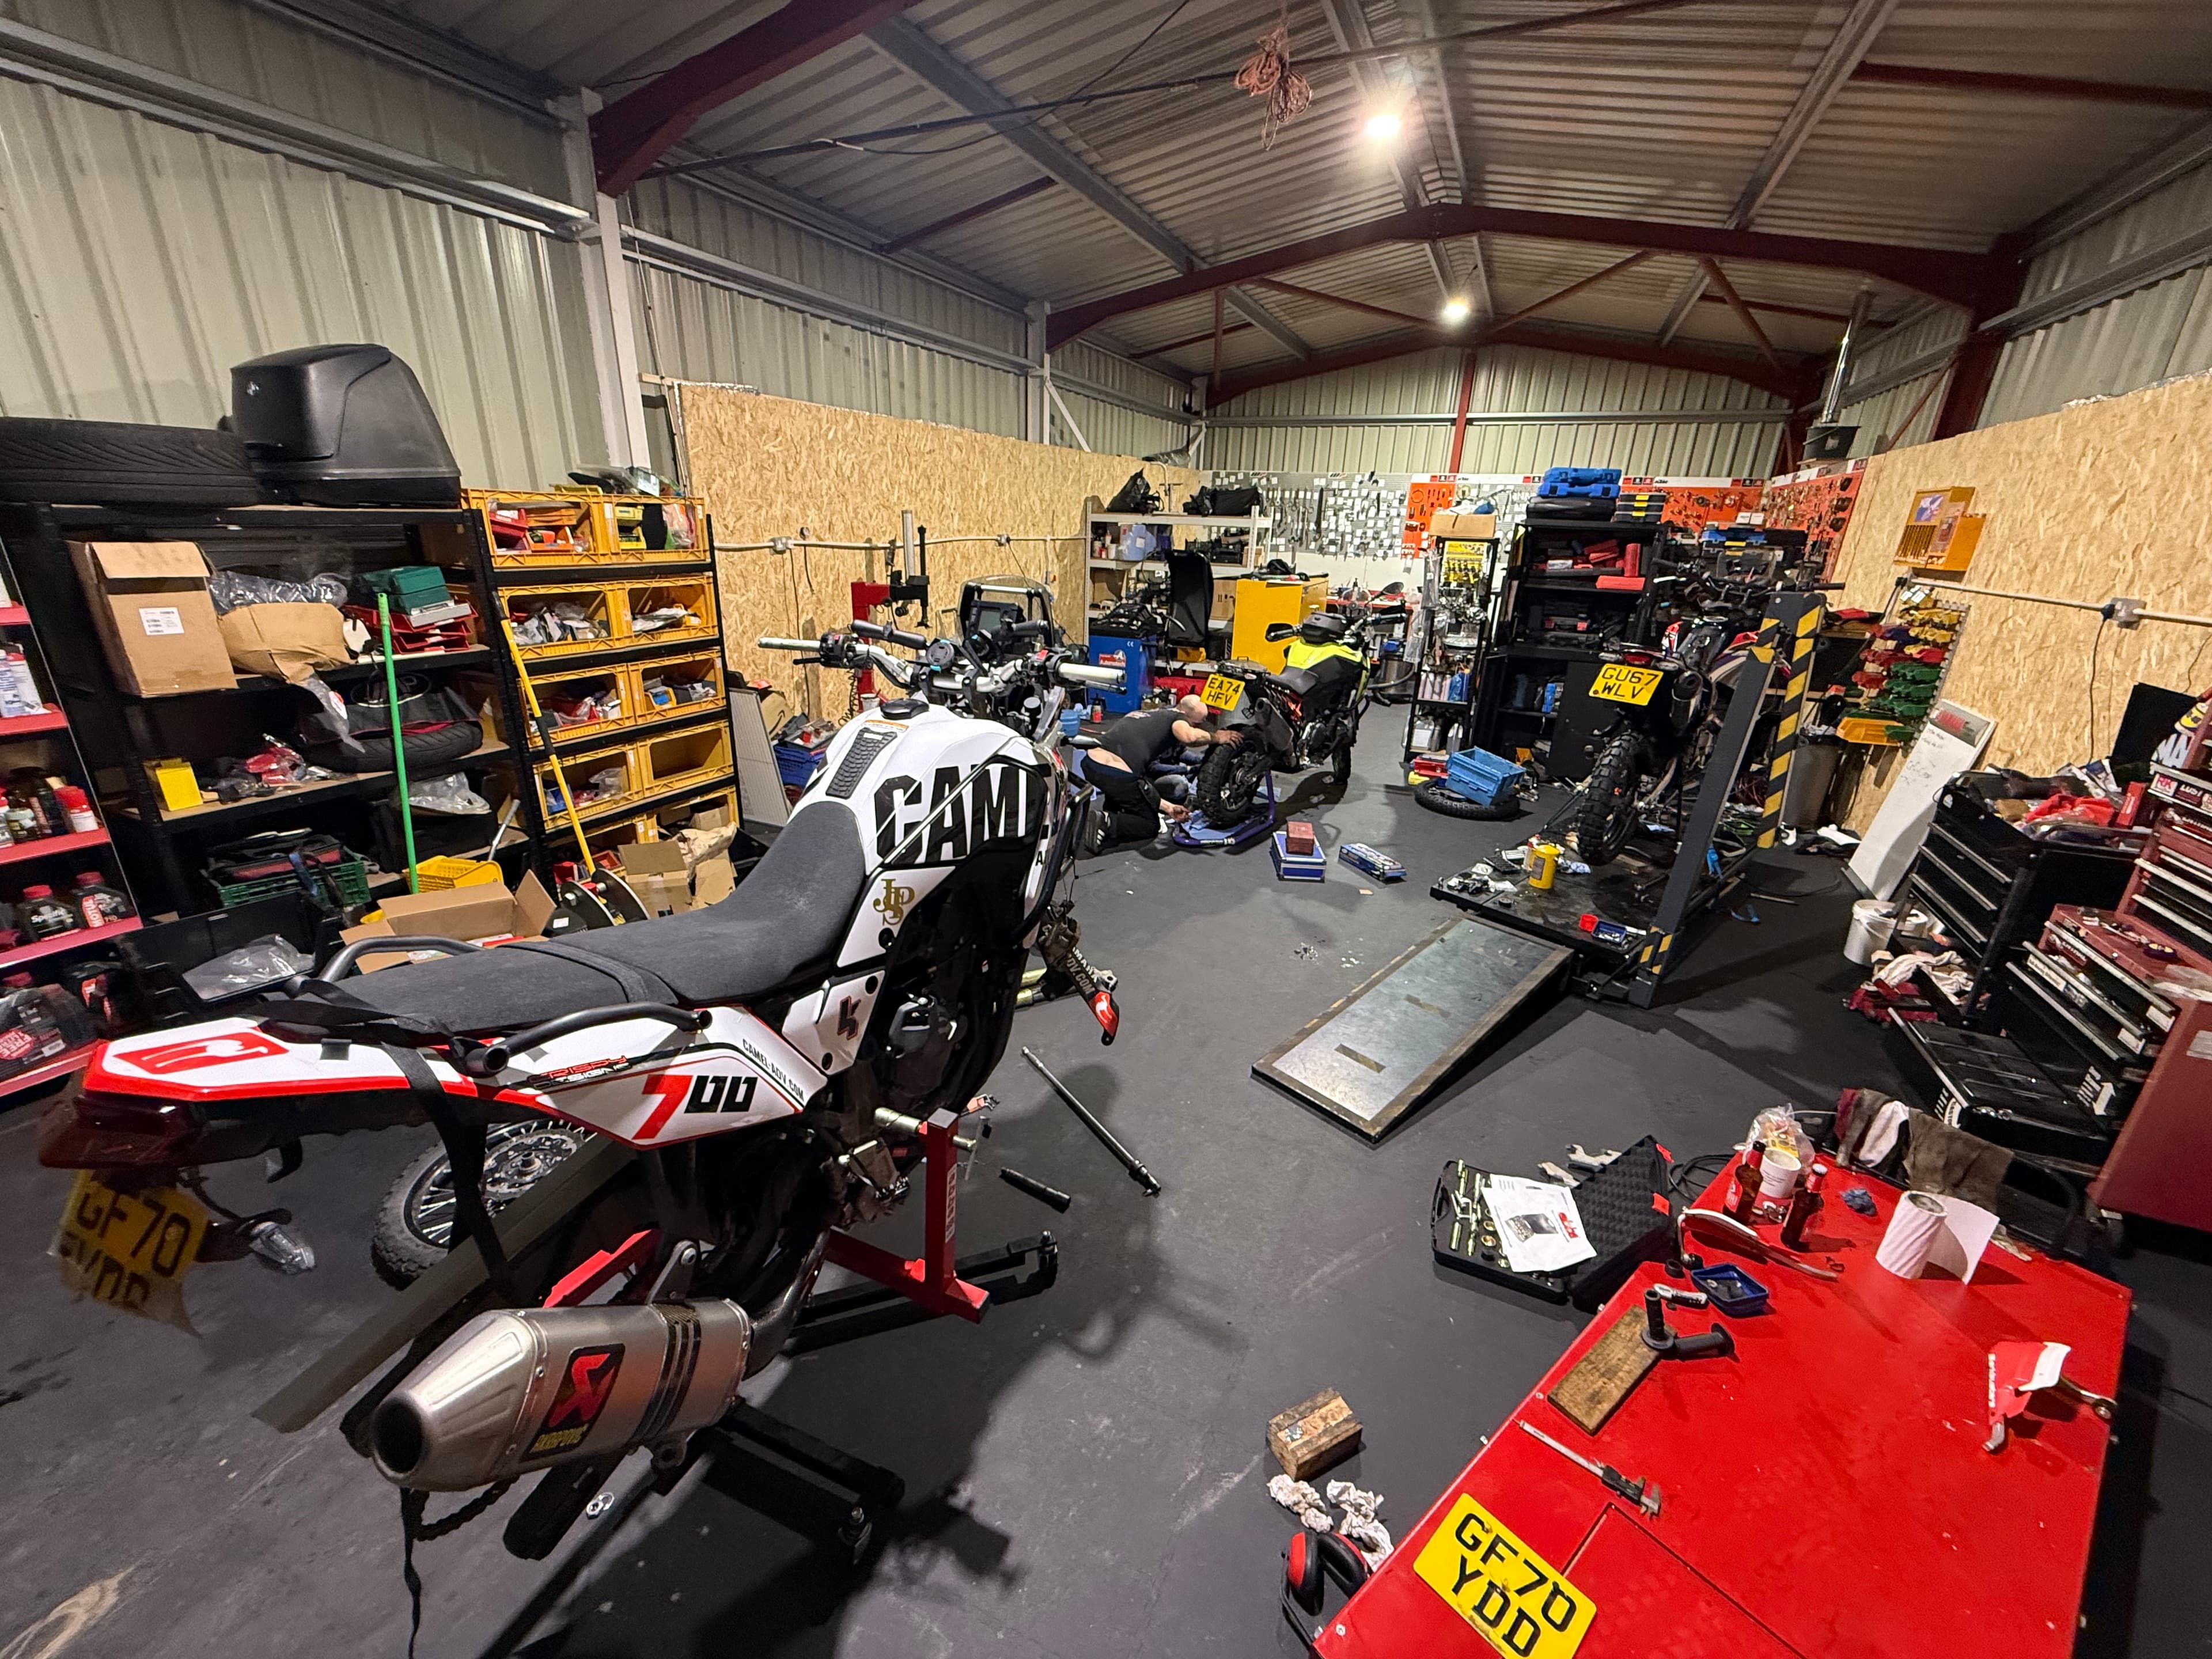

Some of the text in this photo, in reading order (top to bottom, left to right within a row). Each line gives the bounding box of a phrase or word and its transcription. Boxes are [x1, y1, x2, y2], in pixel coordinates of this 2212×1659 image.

[1206, 690, 1233, 706] HFV
[1207, 677, 1241, 695] EA74
[1601, 667, 1660, 686] GU67
[1601, 681, 1645, 699] WLV
[743, 1038, 805, 1102] CAMEL-ADV.COM
[632, 1075, 758, 1140] 700
[75, 1192, 191, 1278] GF70
[1455, 1513, 1577, 1633] GF70
[1451, 1553, 1541, 1658] YDD
